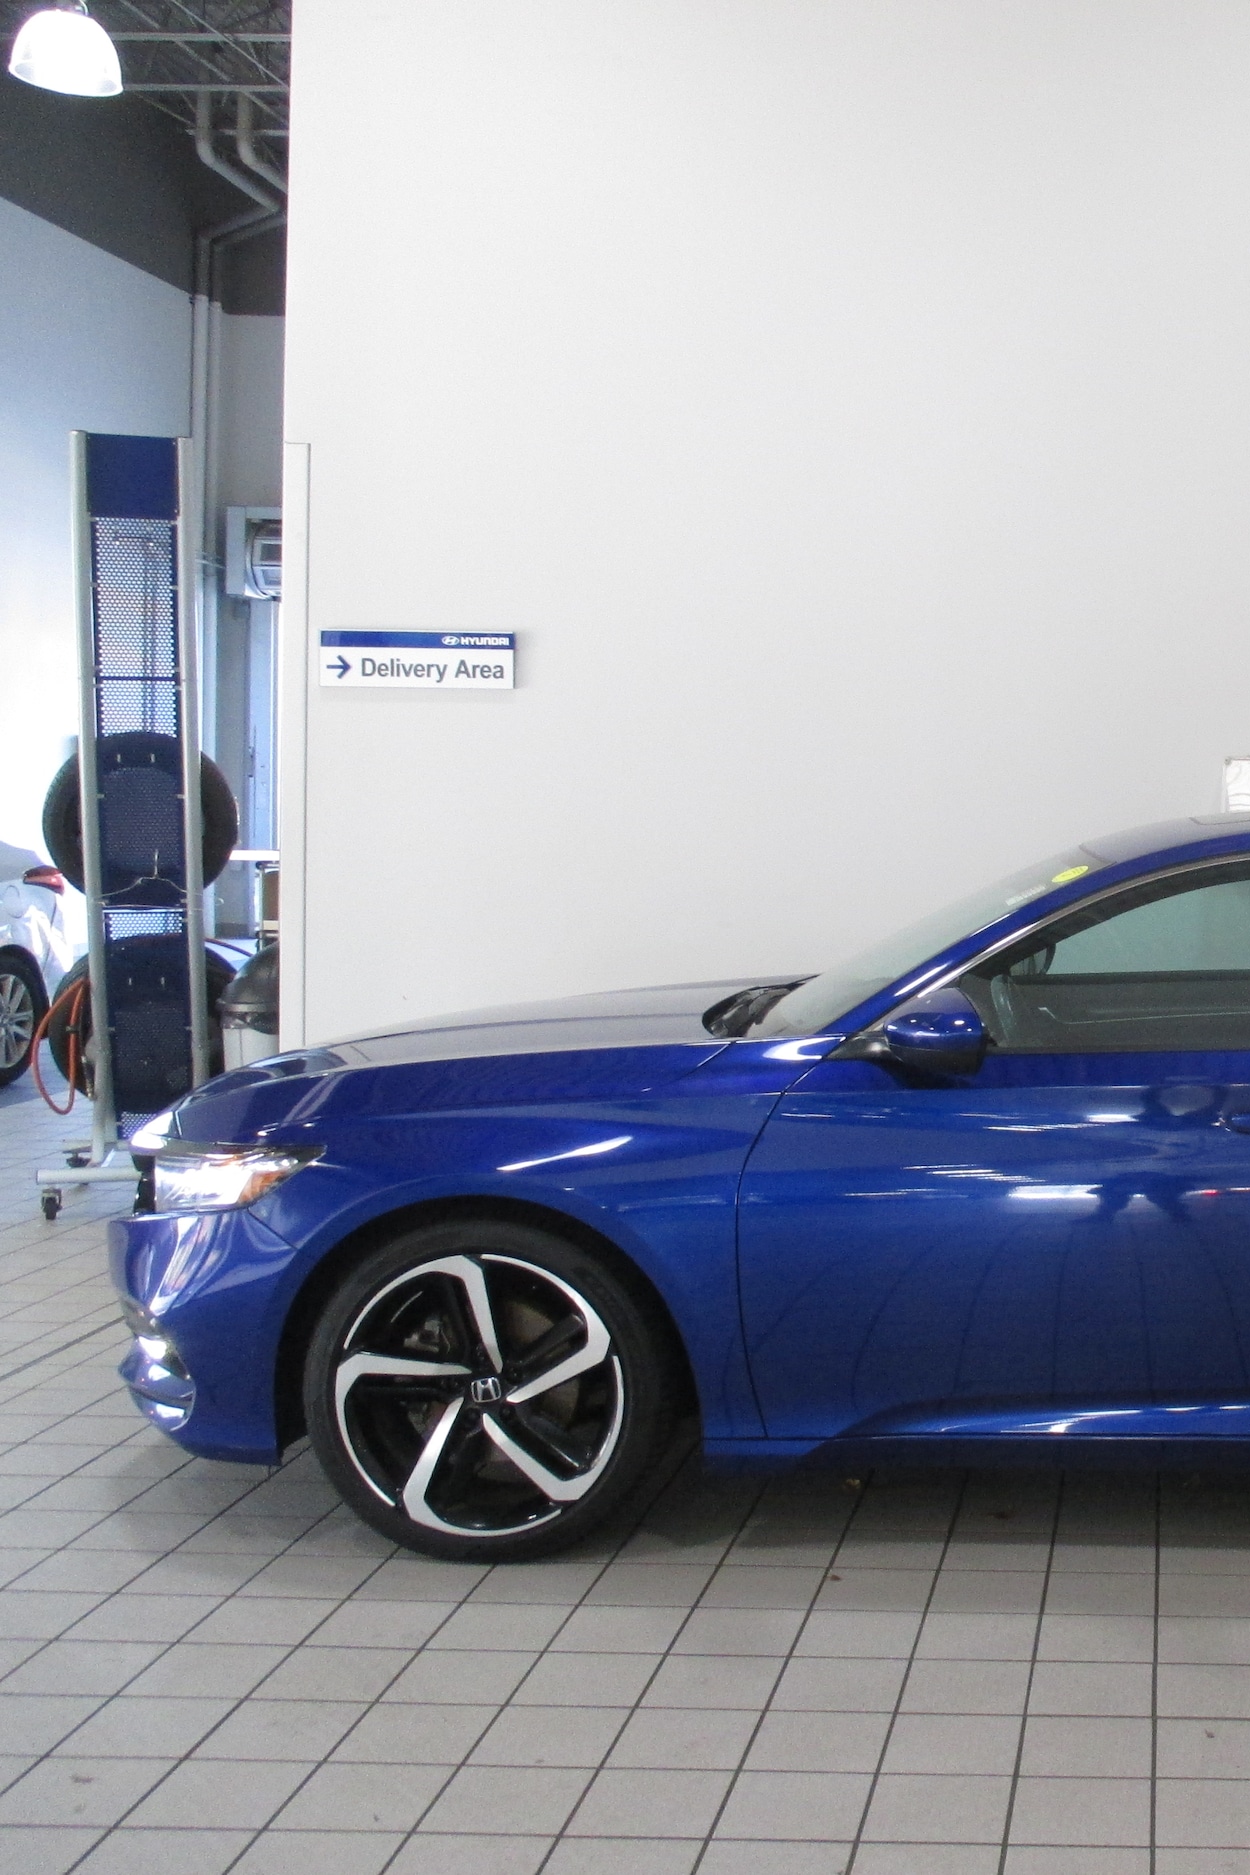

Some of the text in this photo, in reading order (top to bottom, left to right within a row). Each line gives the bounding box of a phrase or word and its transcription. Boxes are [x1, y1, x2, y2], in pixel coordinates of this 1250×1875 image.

[460, 636, 510, 646] HYUNDAI
[361, 657, 505, 683] Delivery Area
